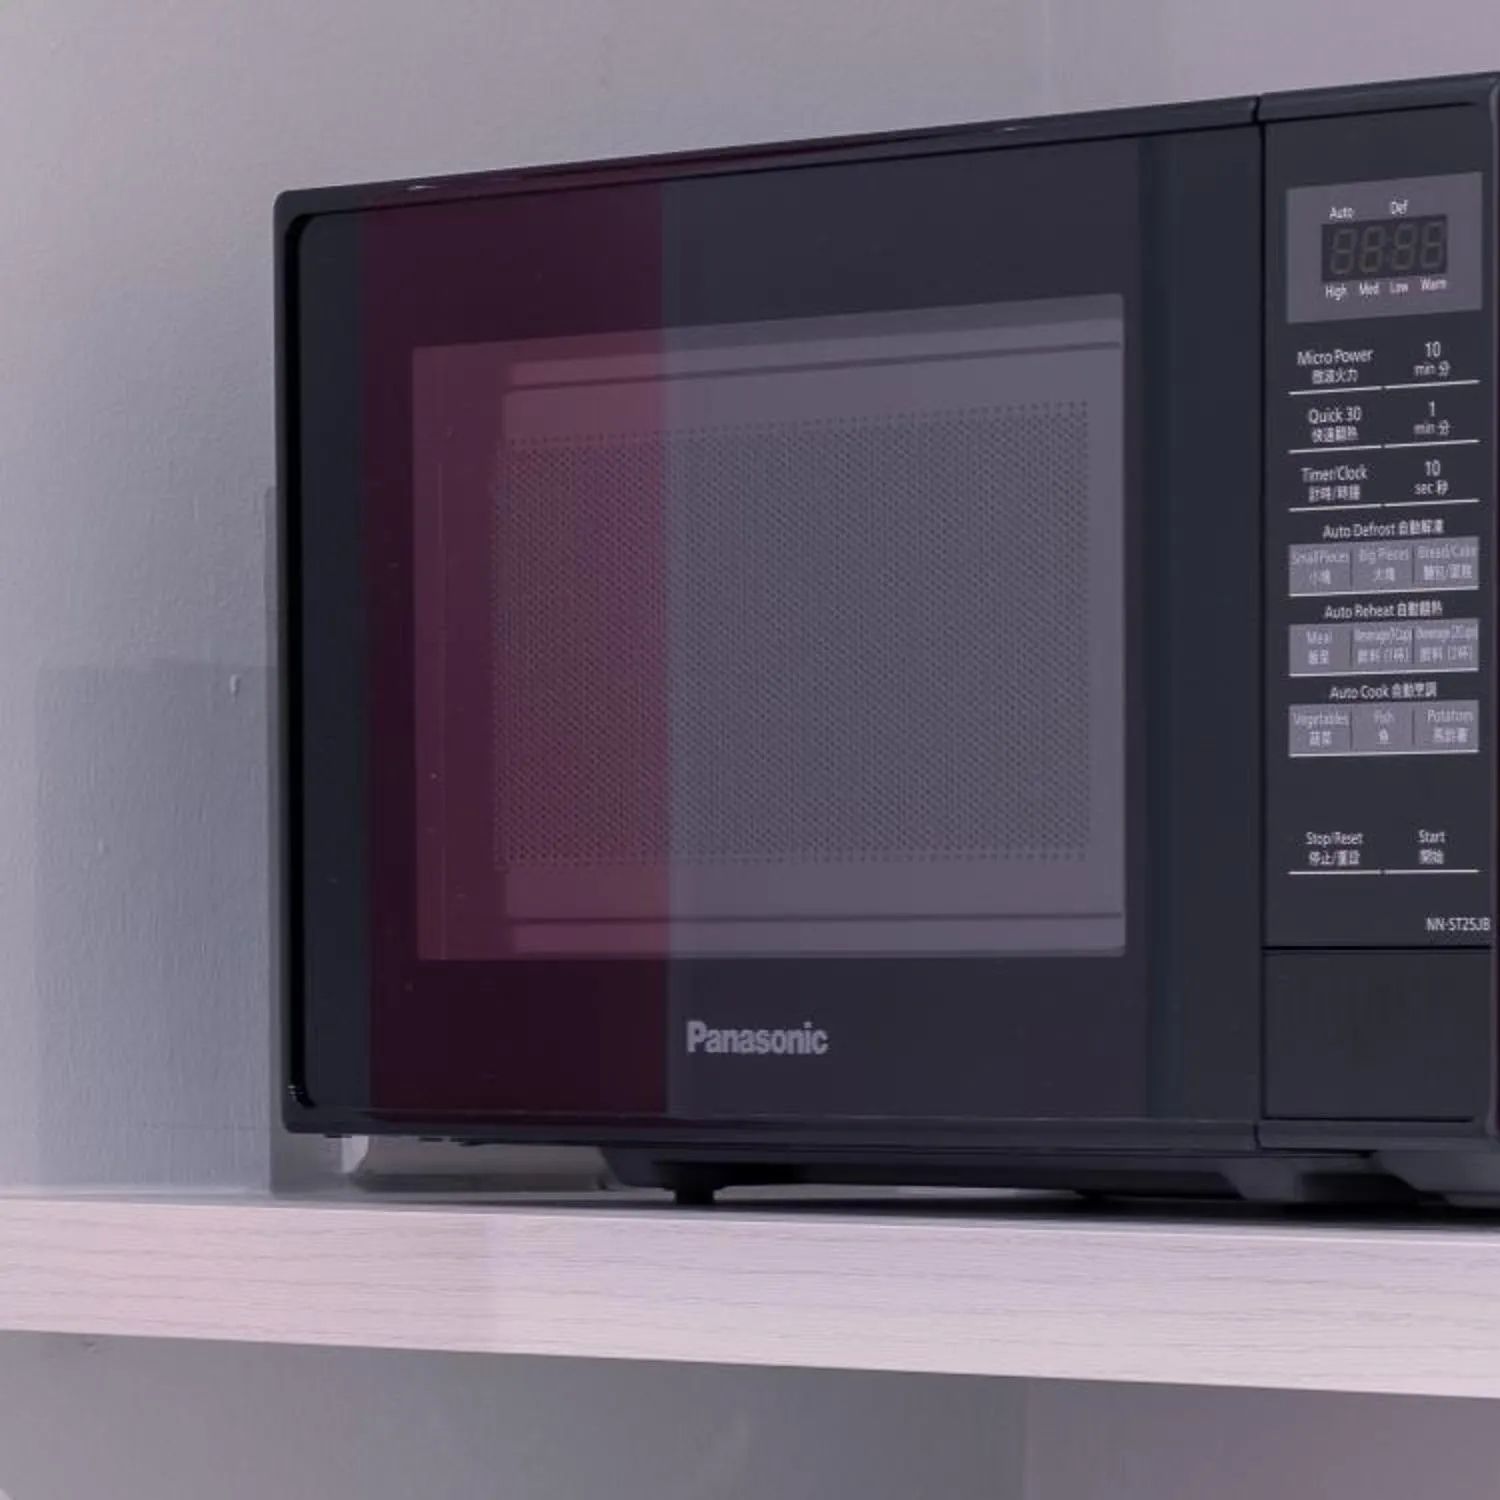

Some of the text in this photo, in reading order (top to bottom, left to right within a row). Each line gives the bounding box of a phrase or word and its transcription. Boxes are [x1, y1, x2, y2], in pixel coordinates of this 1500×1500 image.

[1329, 207, 1354, 219] Auto
[1389, 199, 1408, 215] Def
[1325, 276, 1447, 300] High Med Low Warm
[1297, 349, 1374, 366] Micro Power
[1425, 341, 1441, 358] 10
[1413, 363, 1436, 376] min
[1308, 406, 1362, 424] Quick 30
[1429, 401, 1436, 417] 1
[1413, 423, 1436, 435] min
[1301, 465, 1368, 483] Timer/Clock
[1425, 460, 1441, 477] 10
[1414, 482, 1434, 496] sec
[1322, 525, 1350, 540] Auto
[1352, 521, 1395, 538] Defrost
[1324, 605, 1352, 619] Auto
[1355, 603, 1394, 618] Reheat
[1329, 686, 1358, 699] Auto
[1360, 685, 1389, 698] Cook
[1306, 831, 1363, 847] Stop/Reset
[1419, 829, 1445, 843] Start
[686, 1020, 829, 1055] Panasonic
